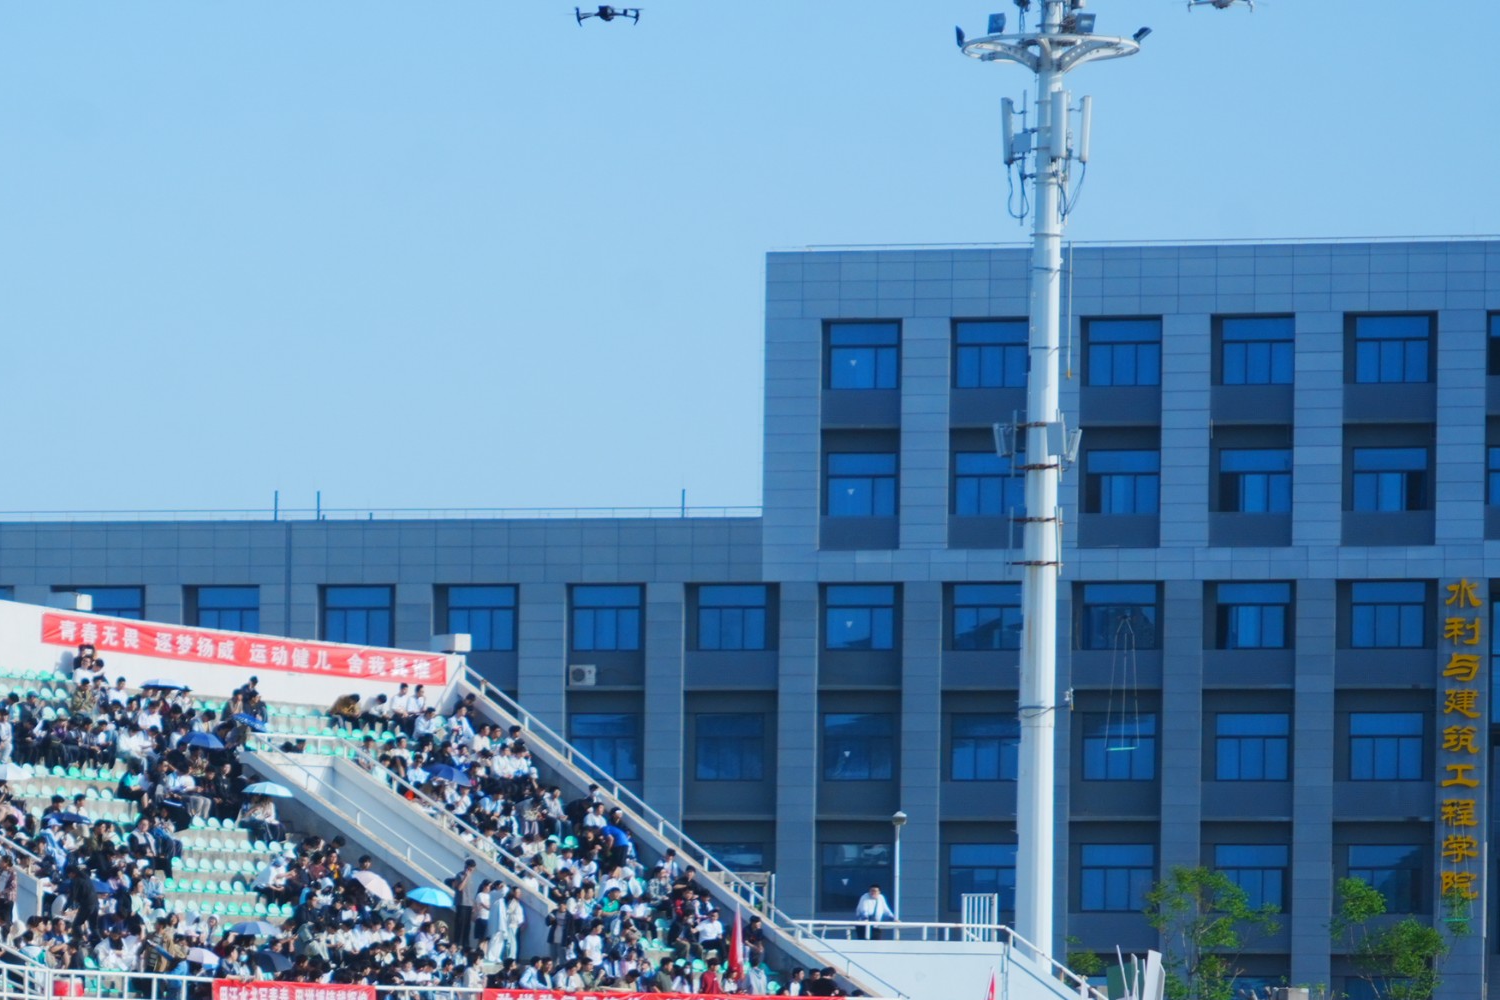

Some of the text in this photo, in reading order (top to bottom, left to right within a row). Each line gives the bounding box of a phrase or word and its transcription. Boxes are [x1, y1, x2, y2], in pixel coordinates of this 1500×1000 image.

[59, 619, 432, 679] 青春无畏 逐梦扬威 运动健儿 舍我其谁
[1440, 578, 1482, 900] 水利与建筑工程学院
